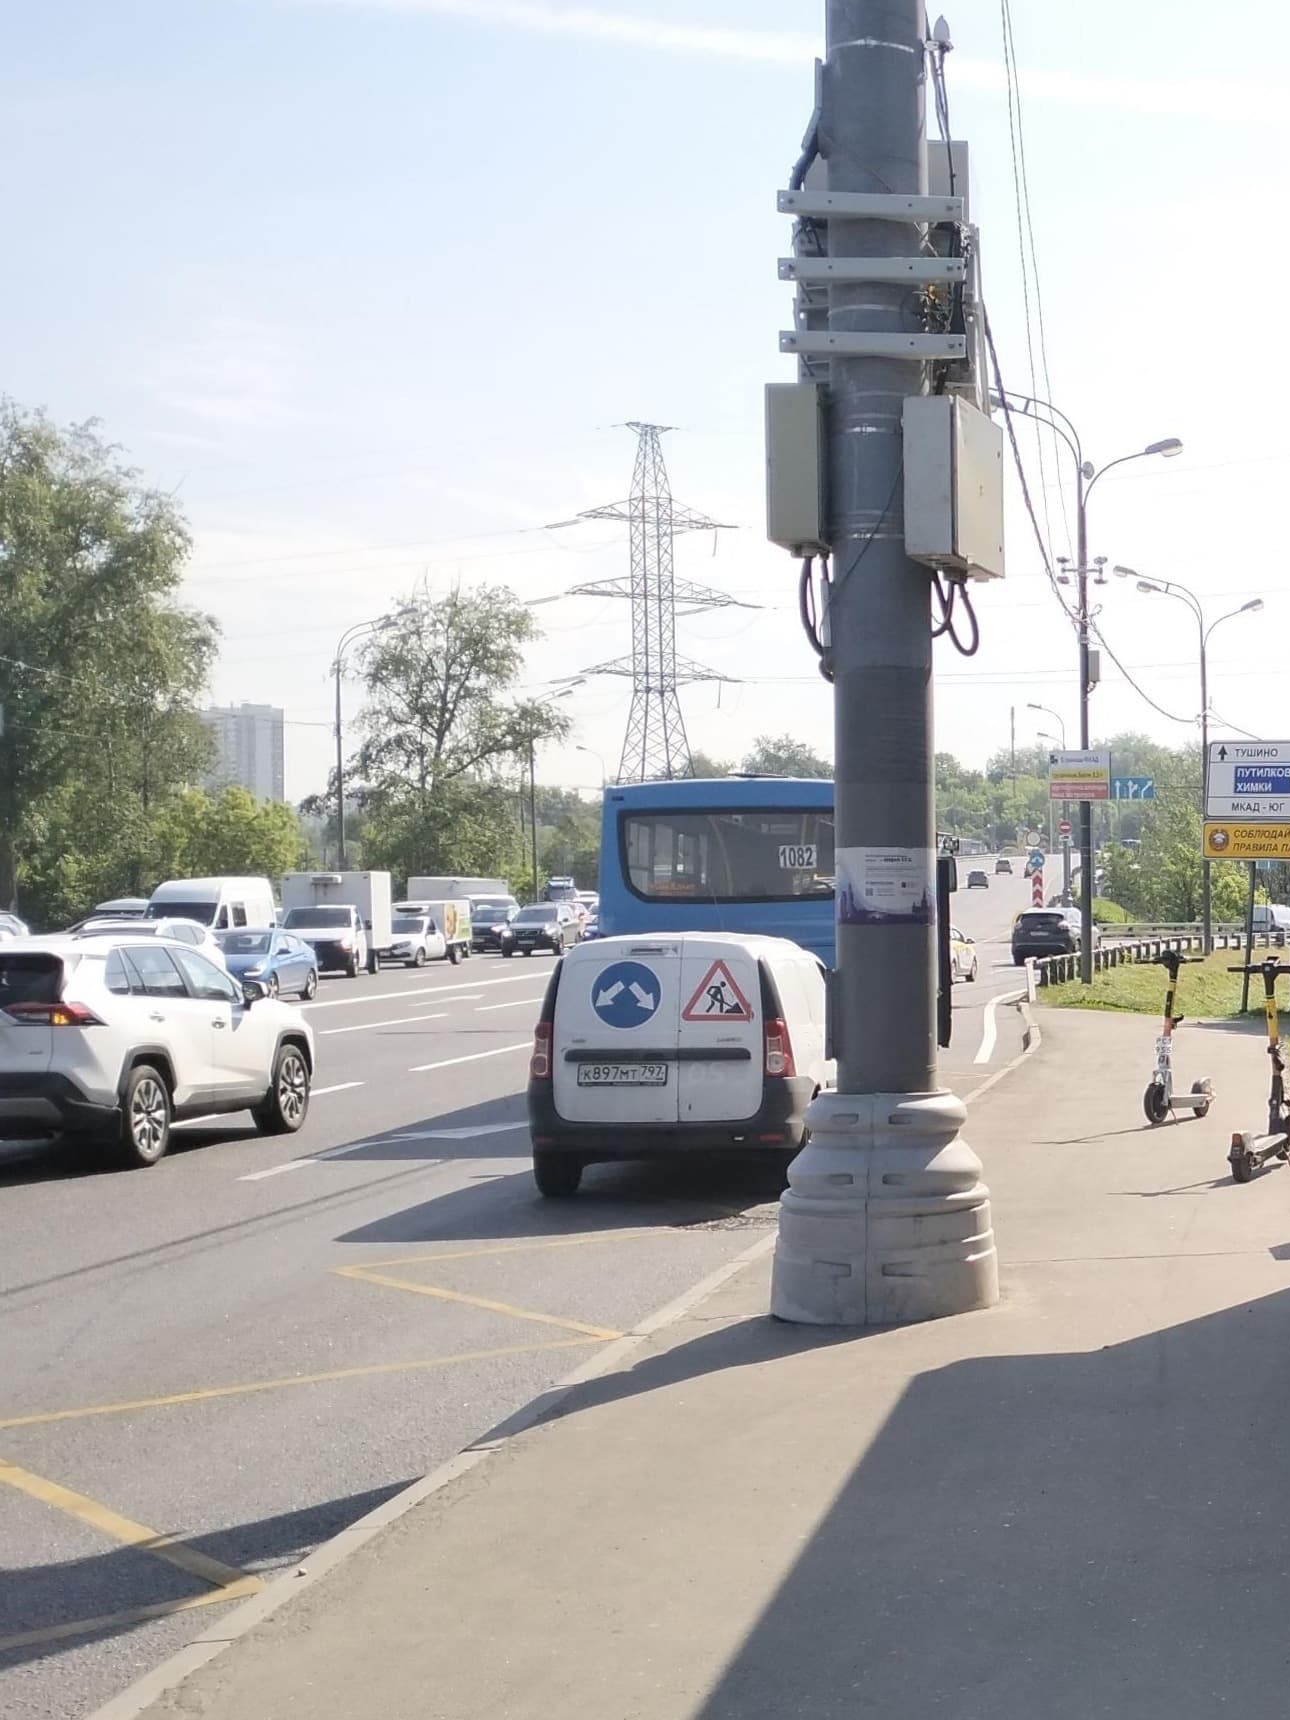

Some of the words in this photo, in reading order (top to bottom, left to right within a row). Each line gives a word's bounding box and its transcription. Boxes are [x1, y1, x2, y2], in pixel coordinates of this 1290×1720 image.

[1235, 748, 1279, 758] ТУШИНО
[1236, 782, 1272, 793] ХИМКИ
[1231, 802, 1260, 813] МКАД
[1269, 802, 1286, 811] ЮГ
[1232, 842, 1279, 853] ПРАВИЛА
[780, 847, 814, 867] 1082
